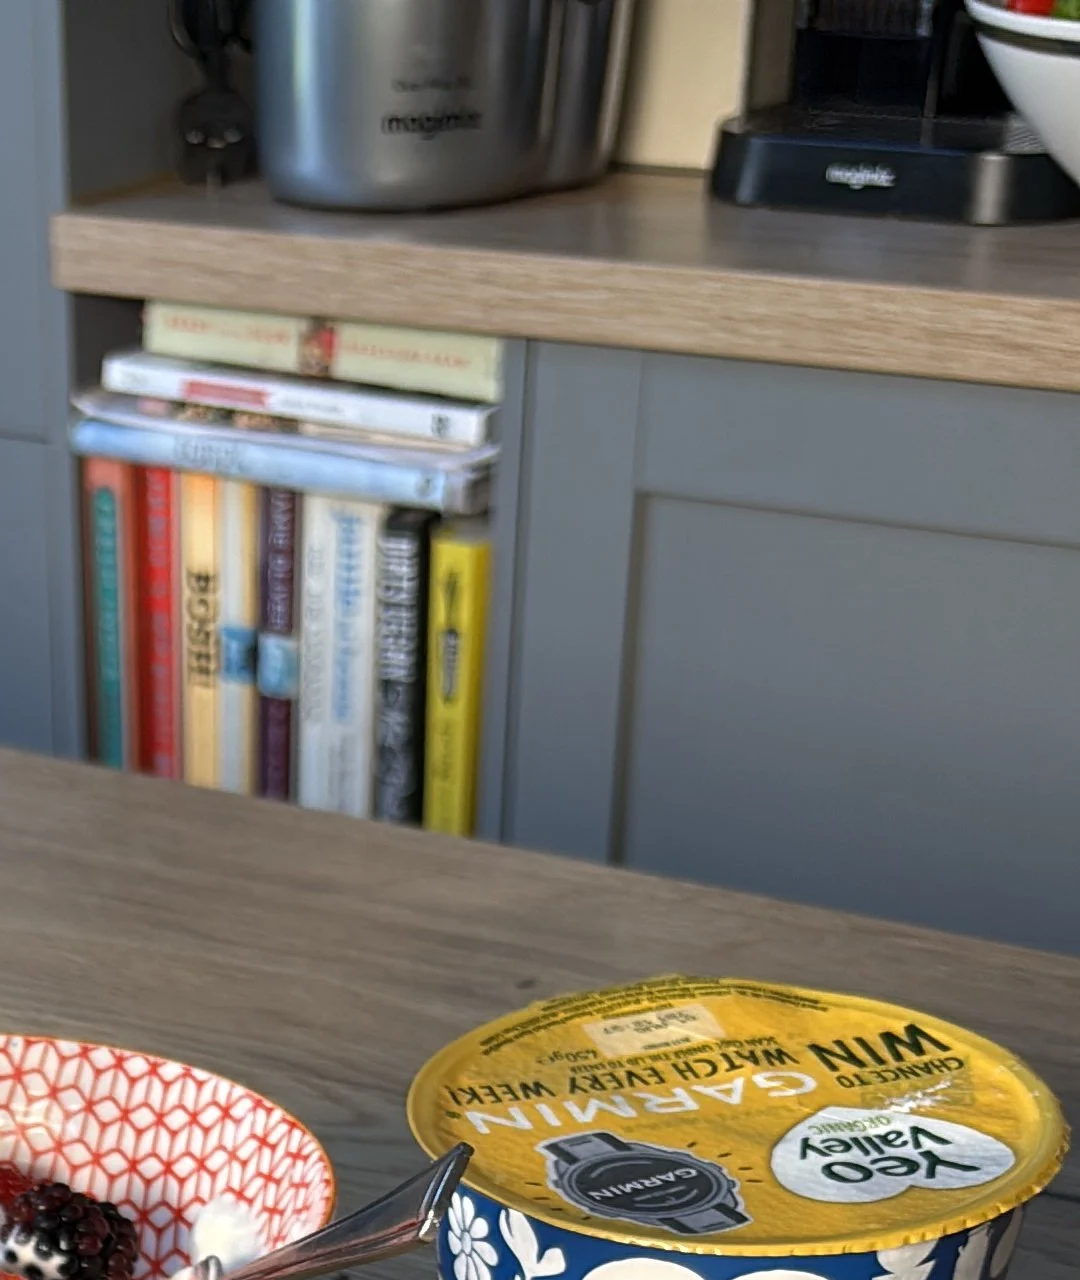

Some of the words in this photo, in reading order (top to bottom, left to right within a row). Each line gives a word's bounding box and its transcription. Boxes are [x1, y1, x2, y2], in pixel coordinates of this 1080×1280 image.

[807, 1023, 952, 1072] WIN
[672, 1047, 800, 1081] WATCH
[838, 1070, 871, 1089] TO
[871, 1056, 964, 1084] CHANCE
[444, 1081, 557, 1107] WEEK!
[569, 1067, 665, 1096] EVERY
[465, 1071, 818, 1135] GARMIN
[808, 1115, 891, 1135] ORGANIC
[799, 1126, 954, 1160] Valley
[822, 1150, 981, 1184] Yeo
[587, 1168, 698, 1200] GARMIN
